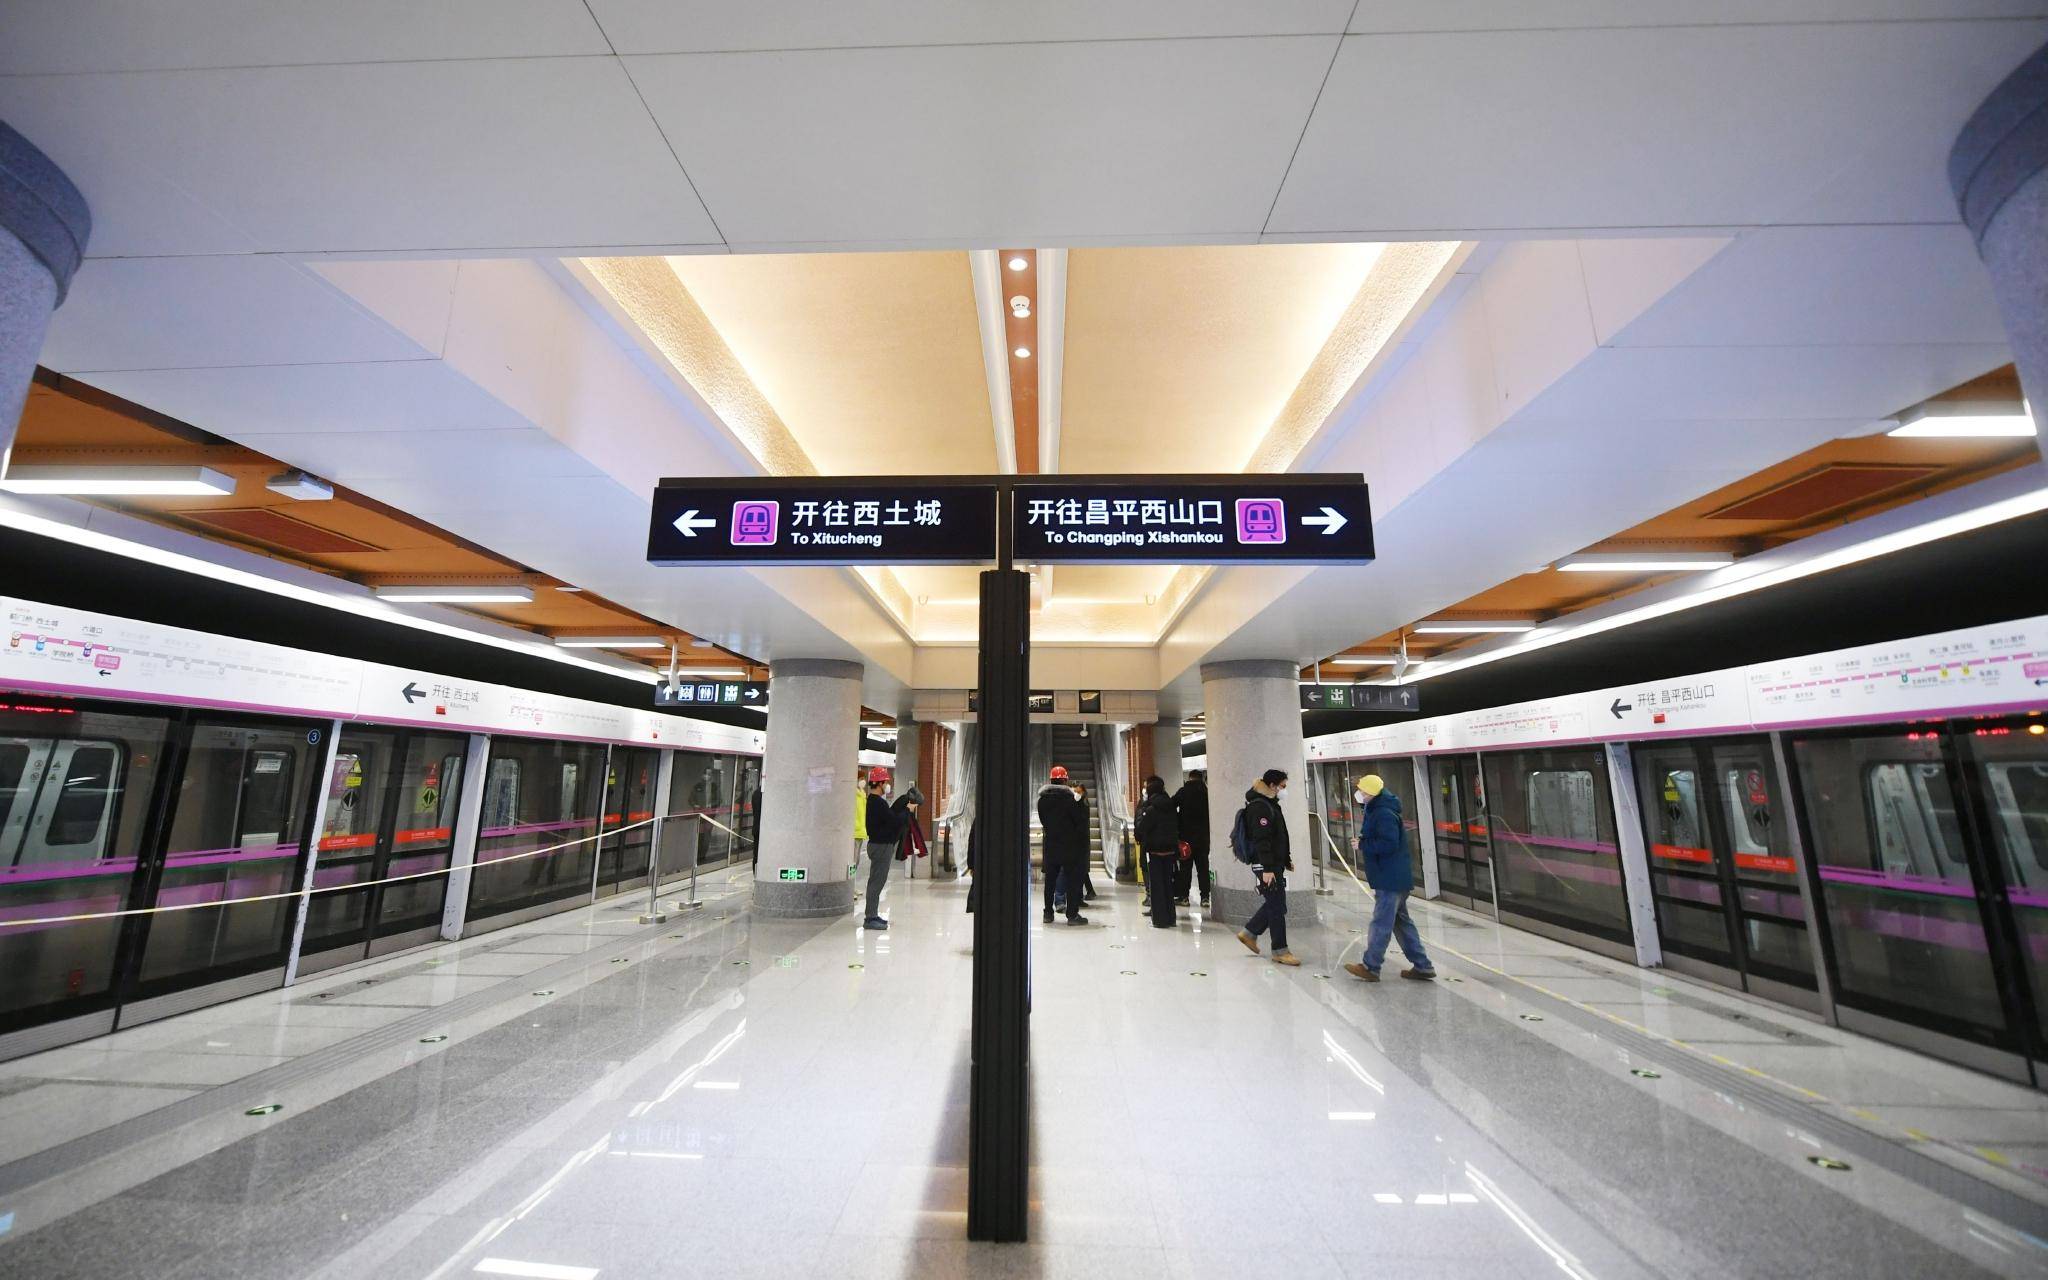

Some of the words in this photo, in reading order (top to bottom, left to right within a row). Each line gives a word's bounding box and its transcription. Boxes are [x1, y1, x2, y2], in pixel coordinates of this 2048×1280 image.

[791, 499, 943, 527] 开往西土城
[1028, 498, 1224, 526] 开往昌平西山口
[791, 532, 810, 546] To
[812, 532, 883, 548] Xitucheng
[1045, 530, 1064, 544] To
[1066, 530, 1145, 547] Changping
[1147, 530, 1224, 544] Xishankou
[432, 684, 451, 699] 开往
[454, 688, 480, 702] 西土城
[1331, 689, 1344, 701] 出
[1637, 692, 1657, 706] 开往
[1661, 684, 1715, 704] 昌平西山口
